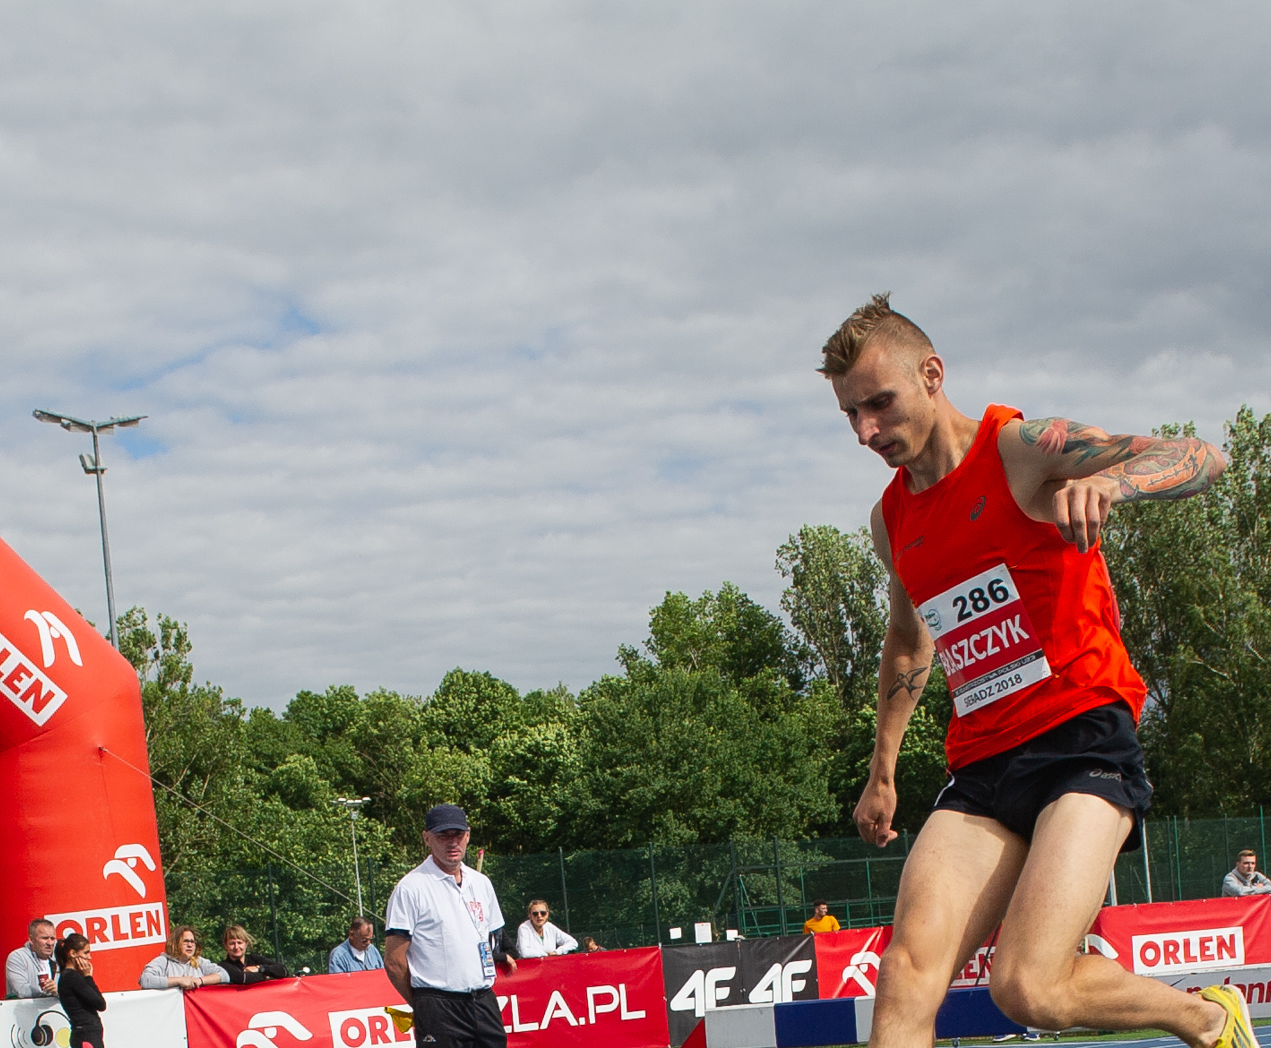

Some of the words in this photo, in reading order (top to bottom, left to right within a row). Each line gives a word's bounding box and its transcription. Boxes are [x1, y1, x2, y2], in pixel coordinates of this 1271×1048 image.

[952, 578, 1010, 623] 286
[994, 673, 1023, 694] 2018
[55, 909, 162, 945] ORLEN
[1139, 932, 1238, 967] ORLEN
[670, 966, 737, 1018] 4F
[748, 958, 813, 1004] 4F
